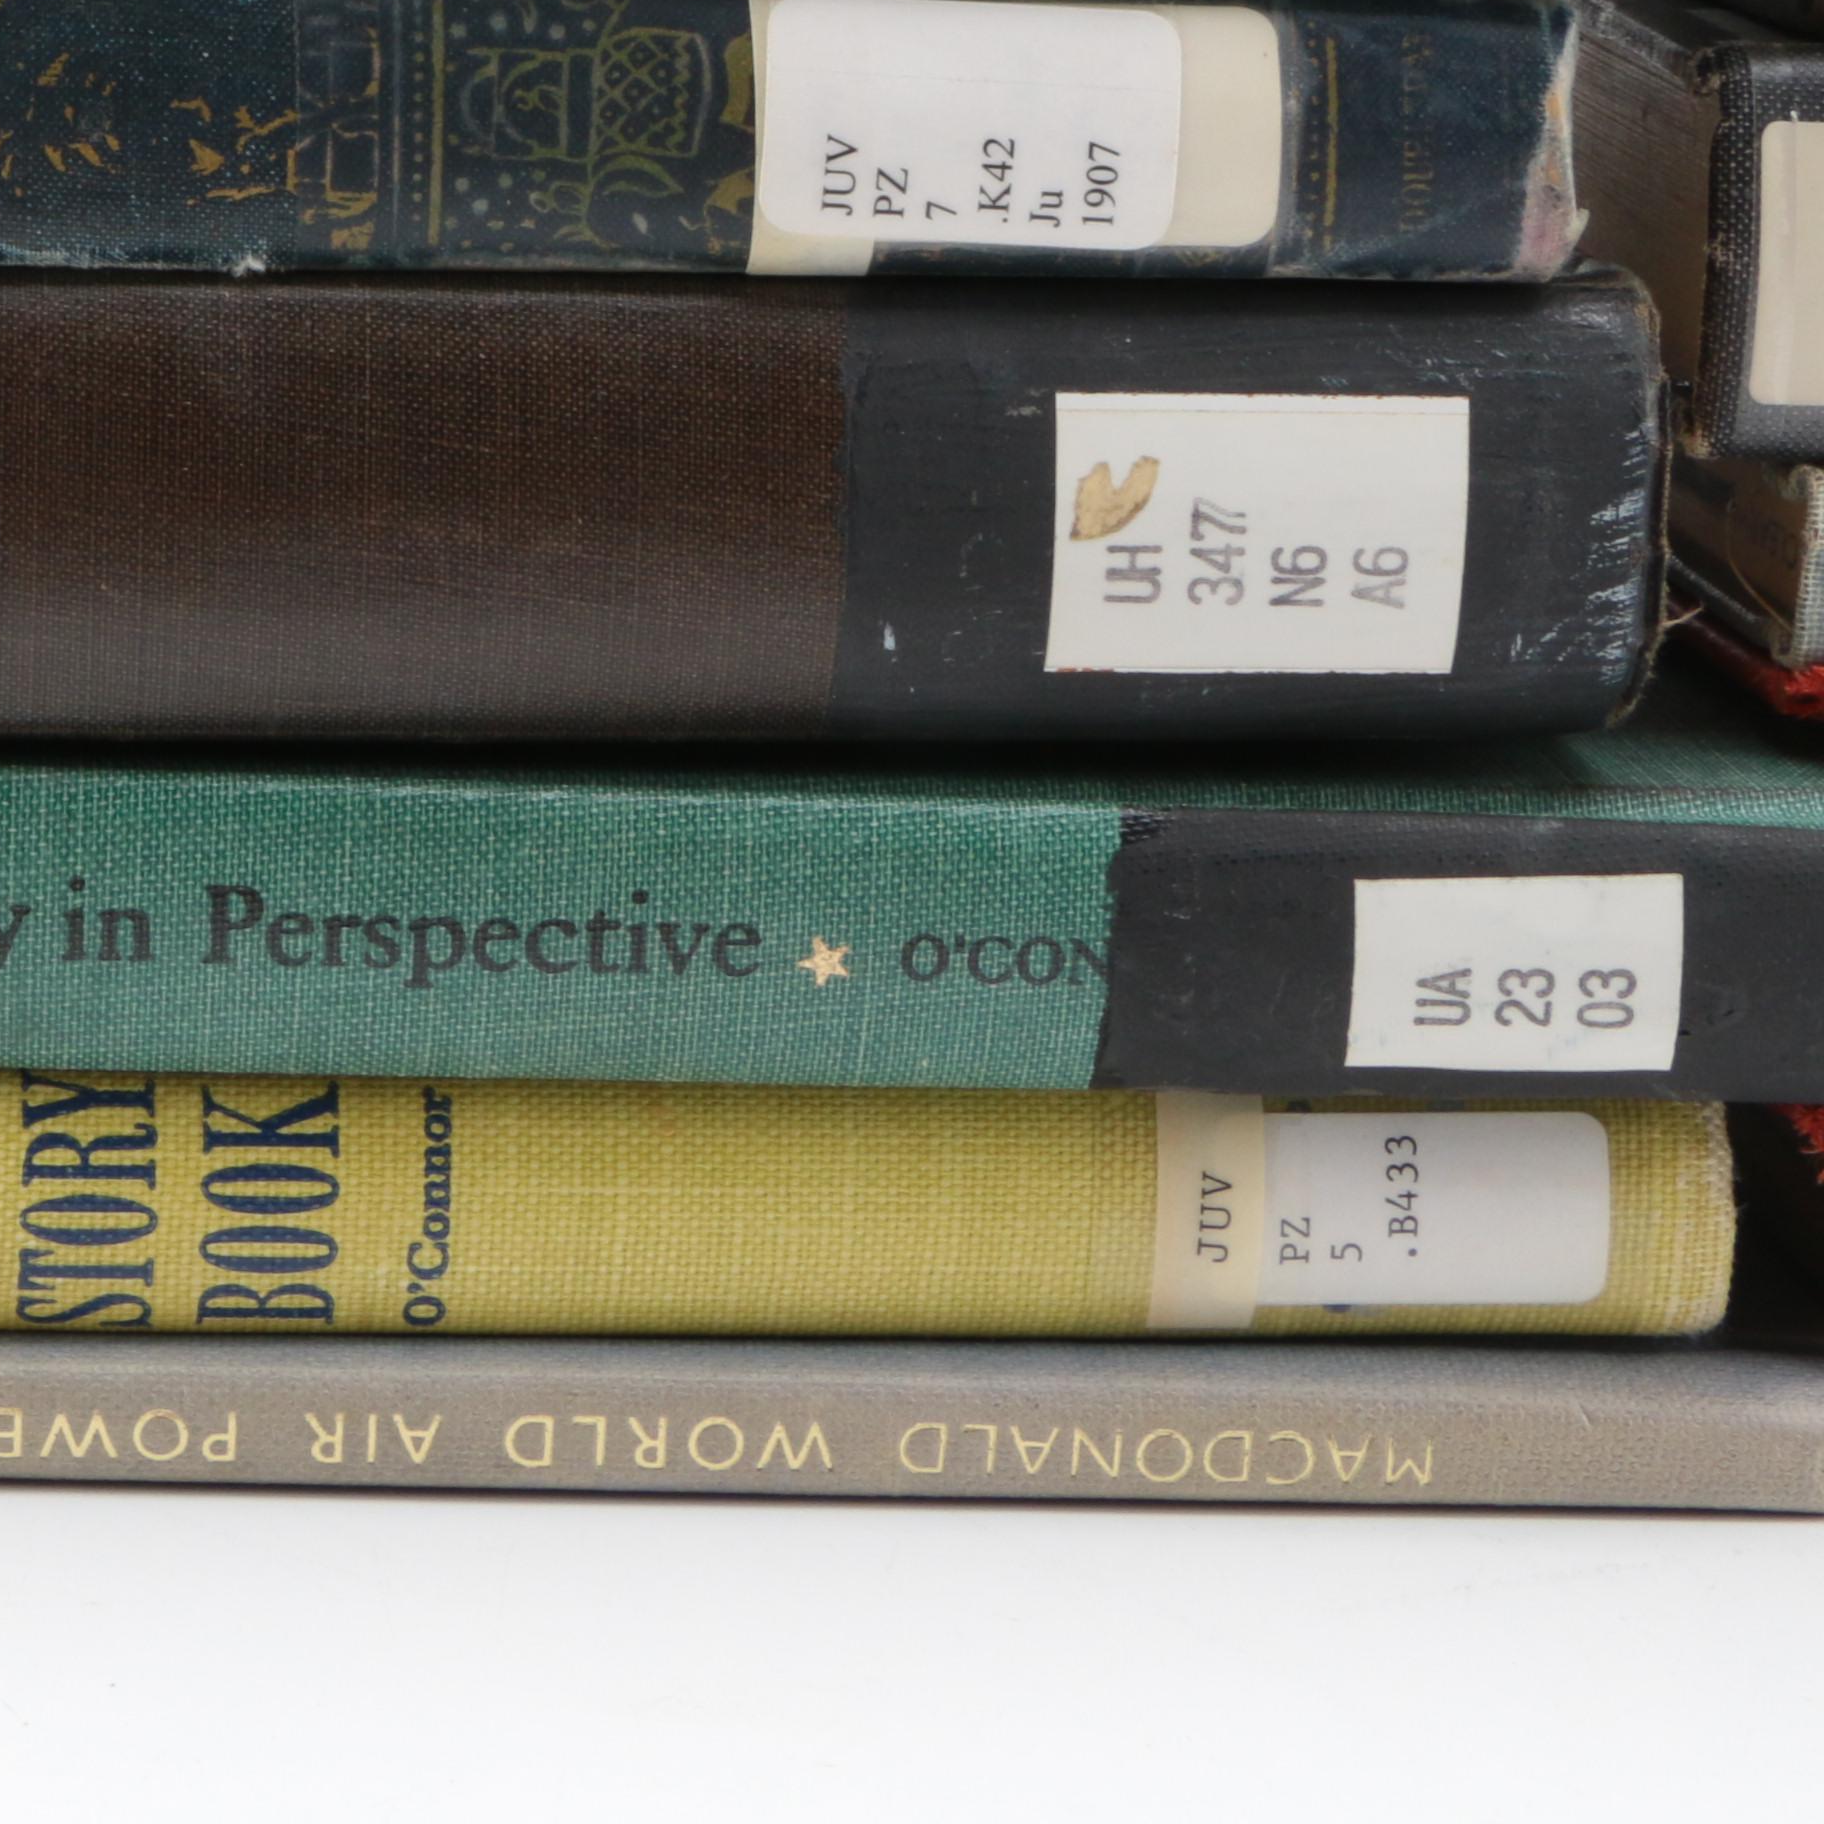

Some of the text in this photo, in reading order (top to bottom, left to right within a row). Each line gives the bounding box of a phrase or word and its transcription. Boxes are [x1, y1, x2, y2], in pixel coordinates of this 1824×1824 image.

[821, 132, 860, 216] JUV
[873, 166, 908, 219] PZ
[978, 136, 1016, 224] .K42
[1081, 140, 1121, 226] 1907
[925, 200, 958, 221] 7
[1029, 189, 1064, 228] Ju
[1102, 544, 1163, 605] UH
[1186, 496, 1248, 607] 347
[1268, 543, 1328, 609] N6
[1350, 545, 1410, 610] A6
[60, 877, 154, 963] in
[202, 881, 763, 989] Perspective
[1413, 966, 1473, 1027] UA
[1493, 967, 1556, 1028] 23
[15, 1067, 159, 1328] STORY
[195, 1079, 342, 1325] BOOK
[402, 1084, 453, 1327] O'Connor
[1196, 1171, 1234, 1264] JUV
[1383, 1134, 1419, 1257] .B433
[1279, 1215, 1311, 1265] PZ
[1330, 1242, 1363, 1262] 5
[303, 1411, 444, 1467] AIR
[503, 1413, 835, 1473] WORLD
[899, 1421, 1436, 1489] MACDONALD
